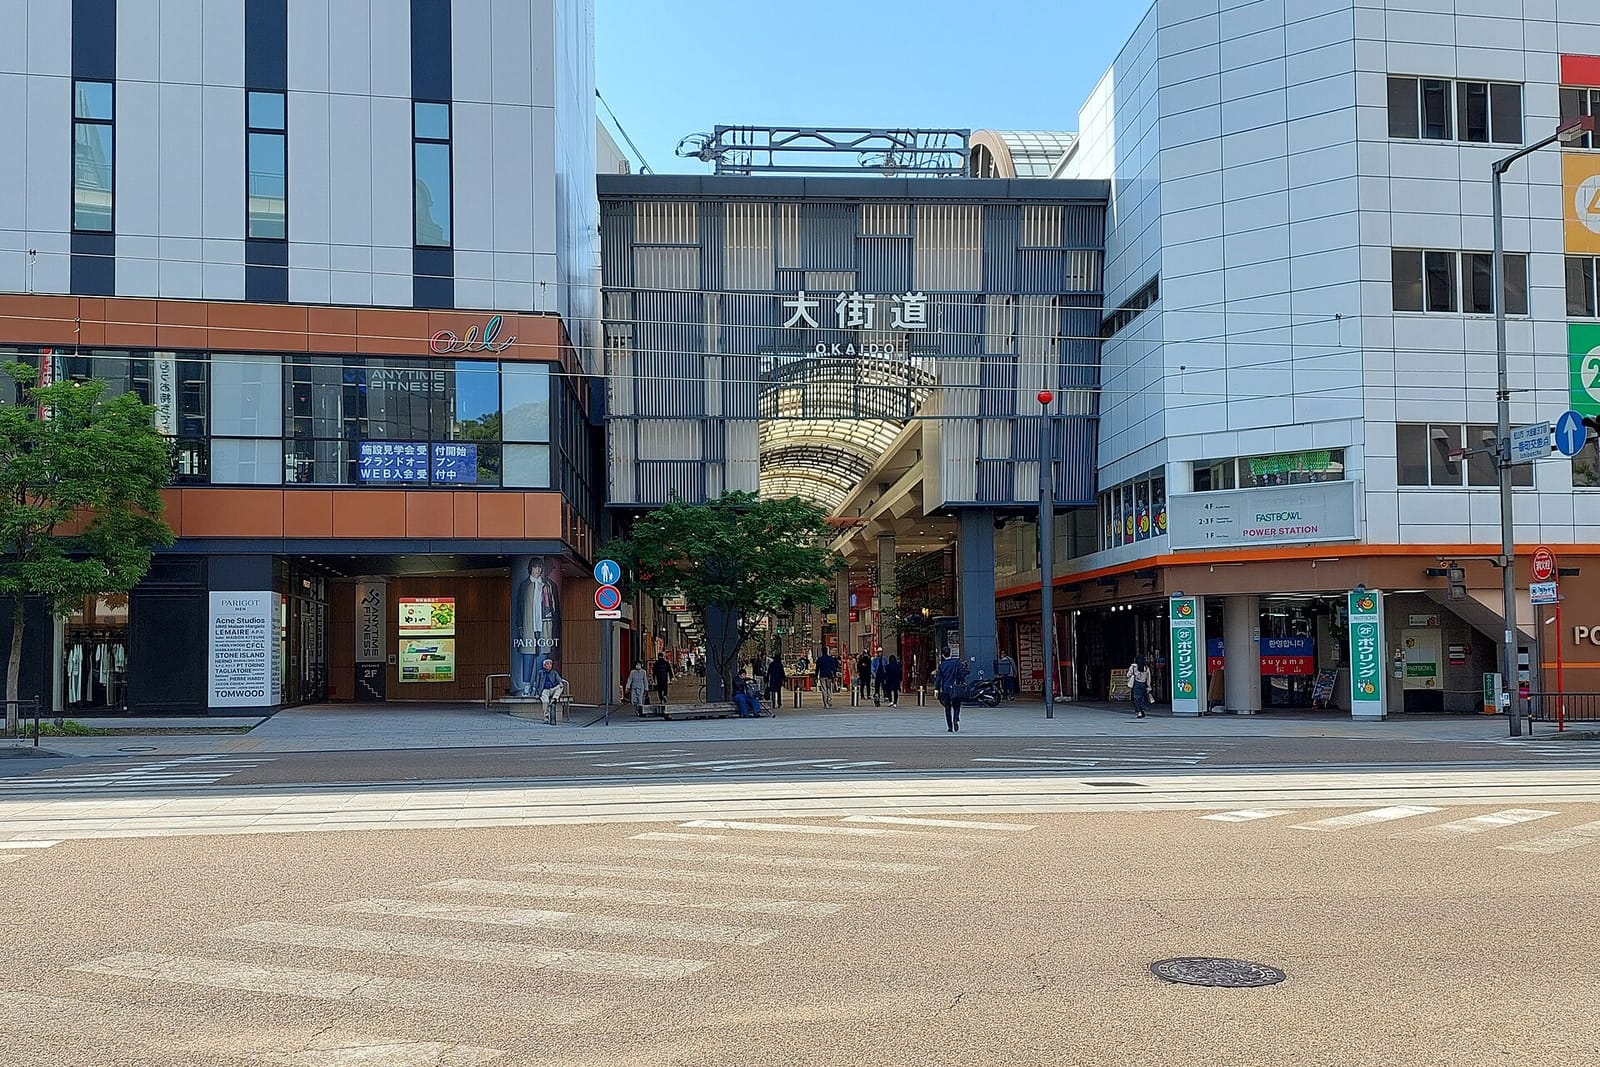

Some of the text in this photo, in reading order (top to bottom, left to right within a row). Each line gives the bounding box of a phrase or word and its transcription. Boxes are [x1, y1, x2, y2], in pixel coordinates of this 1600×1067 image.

[783, 291, 928, 329] 大街道
[371, 369, 445, 381] ANYTIME
[371, 381, 445, 392] FITNESS
[1242, 525, 1318, 537] POWER STATION
[363, 606, 371, 657] FITNESS
[371, 606, 379, 657] ANYTIME
[1180, 630, 1191, 638] 2F
[1360, 627, 1372, 635] 2F
[513, 638, 560, 648] PARIGOT
[1020, 623, 1033, 679] STATION
[1177, 640, 1194, 678] ボウリング
[1357, 637, 1376, 678] ボウリング
[363, 669, 378, 678] 2F
